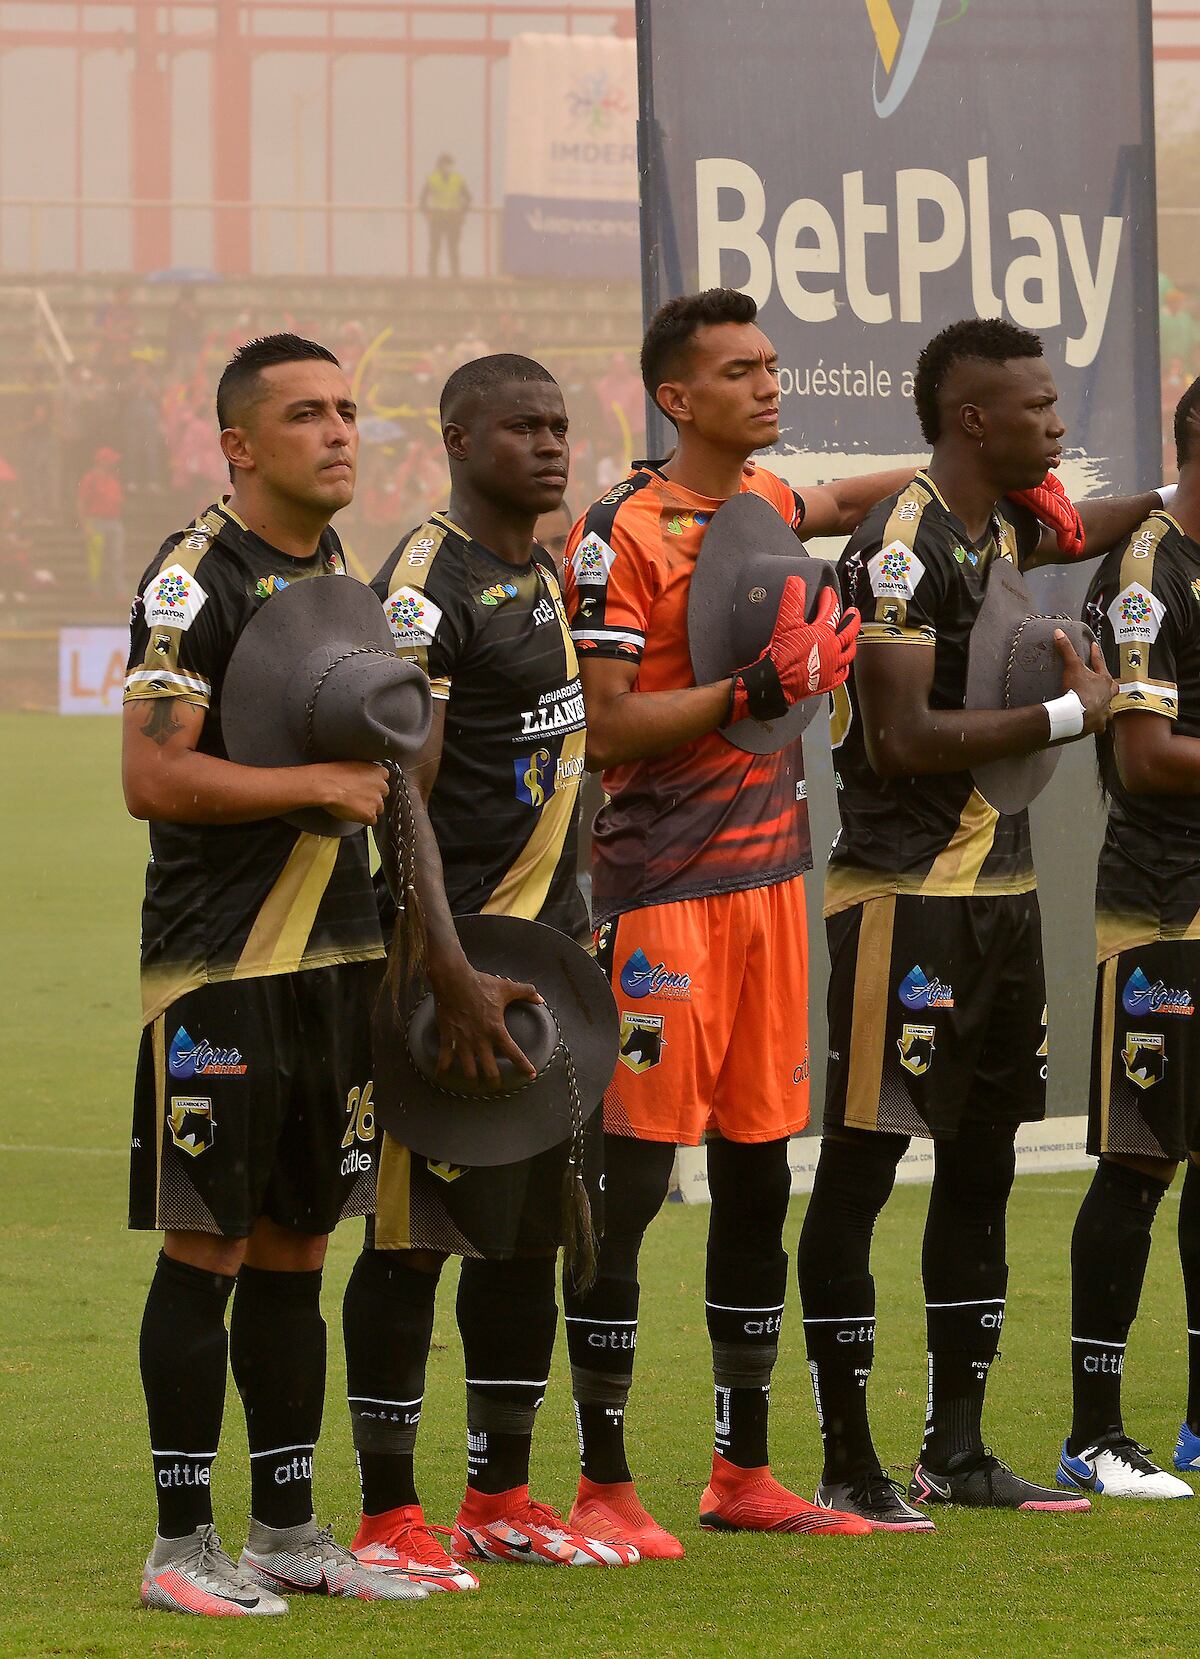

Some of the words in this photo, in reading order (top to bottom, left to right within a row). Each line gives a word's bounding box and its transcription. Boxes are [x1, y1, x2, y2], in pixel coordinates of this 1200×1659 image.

[695, 156, 1123, 368] BetPlay
[777, 360, 892, 402] puéstale
[408, 538, 434, 567] attle
[1119, 626, 1151, 634] DIMAYOR
[341, 1081, 375, 1149] 26
[341, 1149, 372, 1177] attle
[158, 1464, 210, 1488] attle
